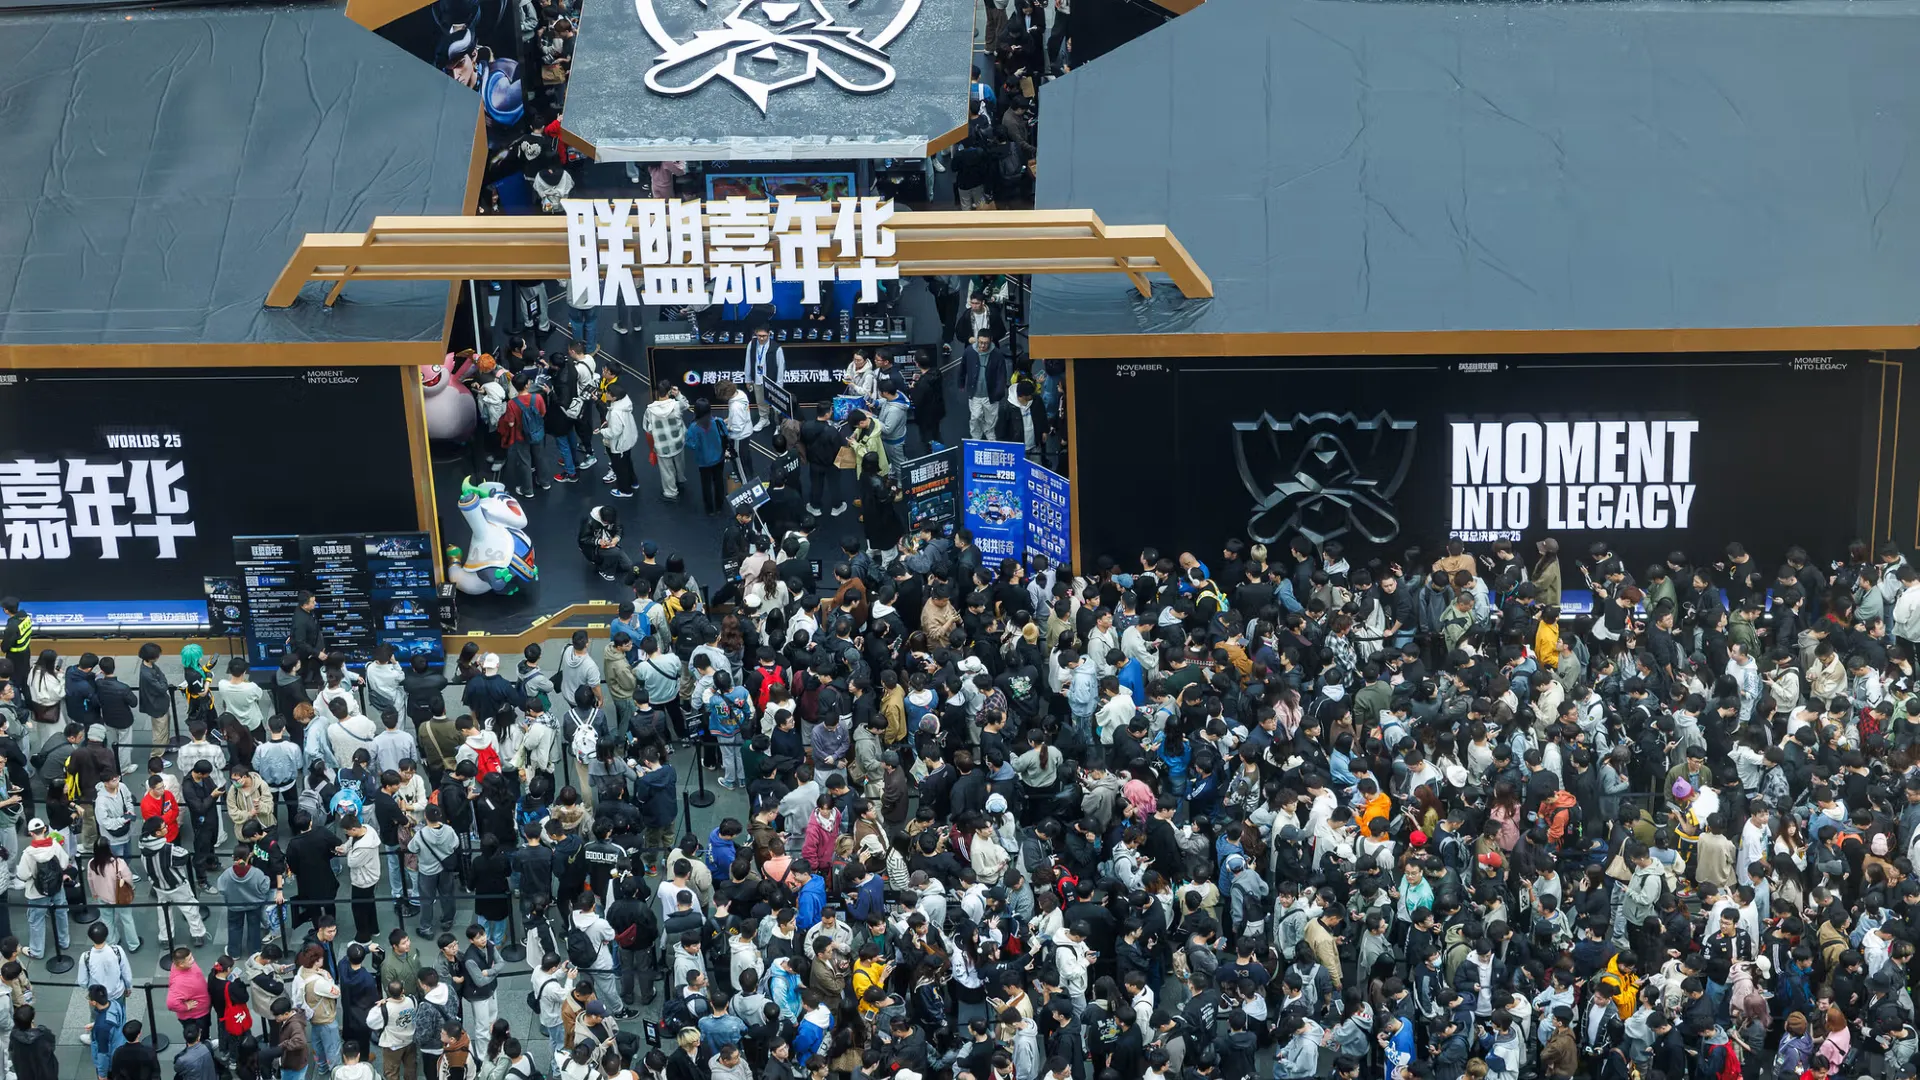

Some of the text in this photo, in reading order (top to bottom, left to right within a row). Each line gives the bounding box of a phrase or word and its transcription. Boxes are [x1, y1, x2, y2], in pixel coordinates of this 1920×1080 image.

[563, 195, 900, 307] 联盟嘉年华
[1794, 356, 1833, 364] MOMENT
[107, 434, 182, 449] WORLDS 25
[974, 450, 1016, 467] 联盟嘉年华
[1449, 420, 1700, 485] MOMENT
[910, 460, 949, 484] 联盟嘉年华
[0, 458, 197, 560] 嘉年华
[1451, 484, 1697, 530] INTO LEGACY
[251, 545, 284, 556] 联盟嘉年华
[312, 544, 353, 556] 我们是联盟
